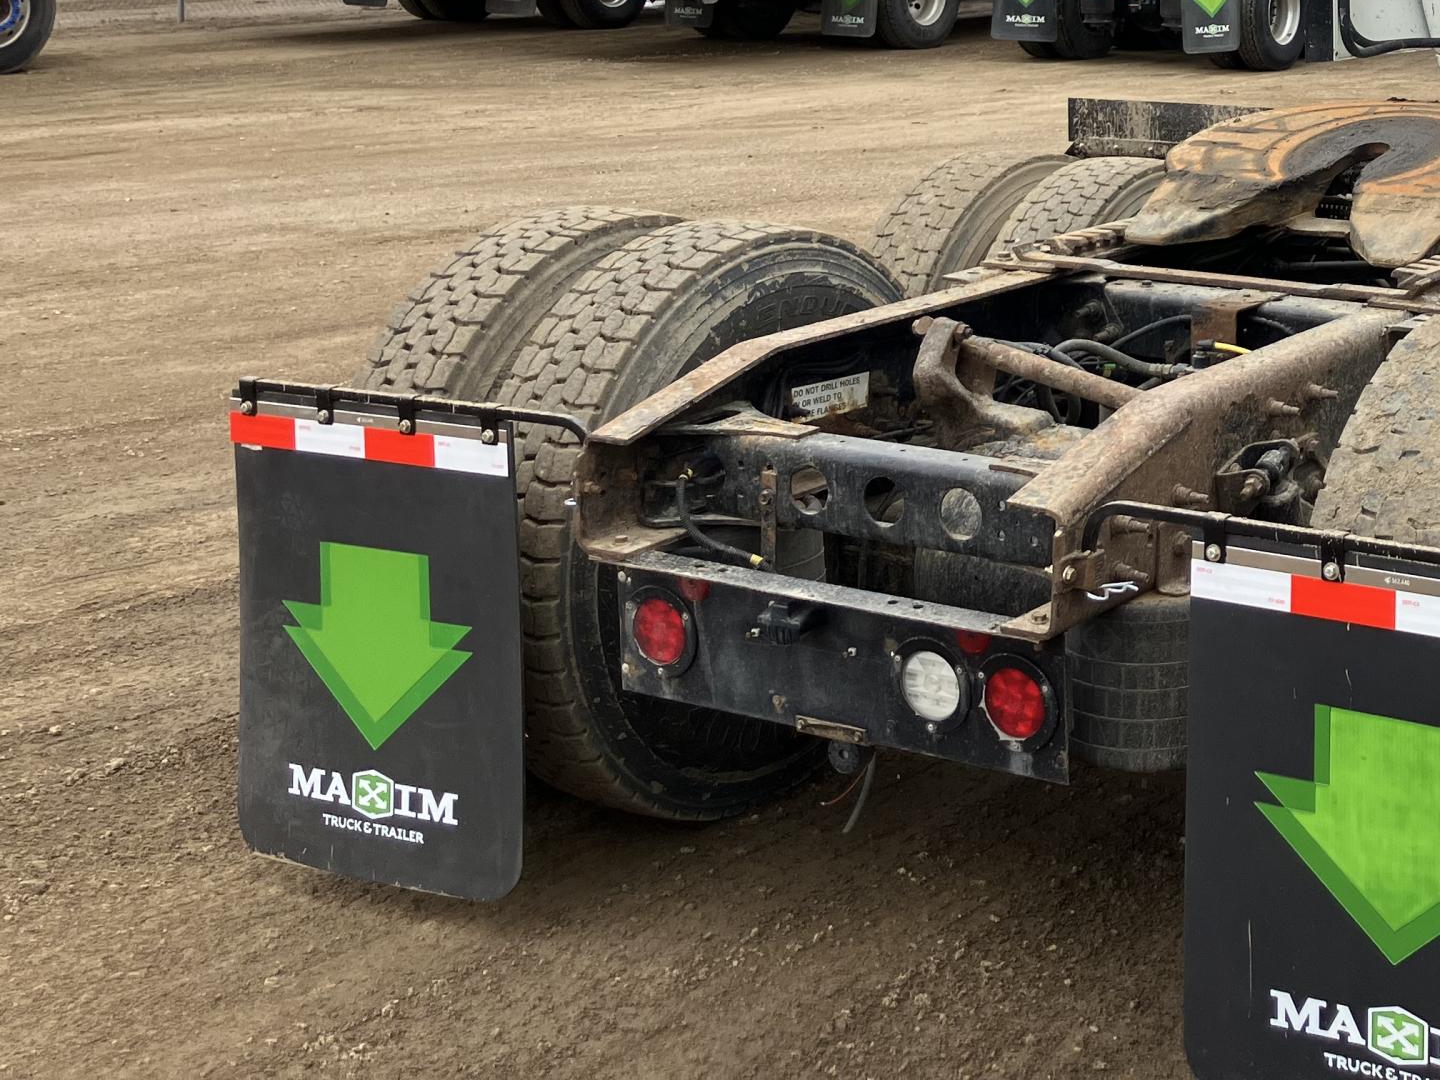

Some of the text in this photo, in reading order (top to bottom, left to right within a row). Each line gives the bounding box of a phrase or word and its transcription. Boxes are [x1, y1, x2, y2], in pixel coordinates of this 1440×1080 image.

[831, 14, 865, 24] MAXIM
[1005, 13, 1046, 24] MAXIM
[1194, 23, 1230, 35] MAXIM
[793, 376, 861, 398] DO NOT DRILL HOLES
[801, 398, 812, 407] OR
[812, 394, 831, 405] WELD
[833, 391, 842, 401] TO
[288, 763, 459, 826] MAXIM
[322, 813, 425, 845] TRUCK & TRAILER
[1323, 1052, 1383, 1079] TRUCK
[1385, 1067, 1398, 1080] &
